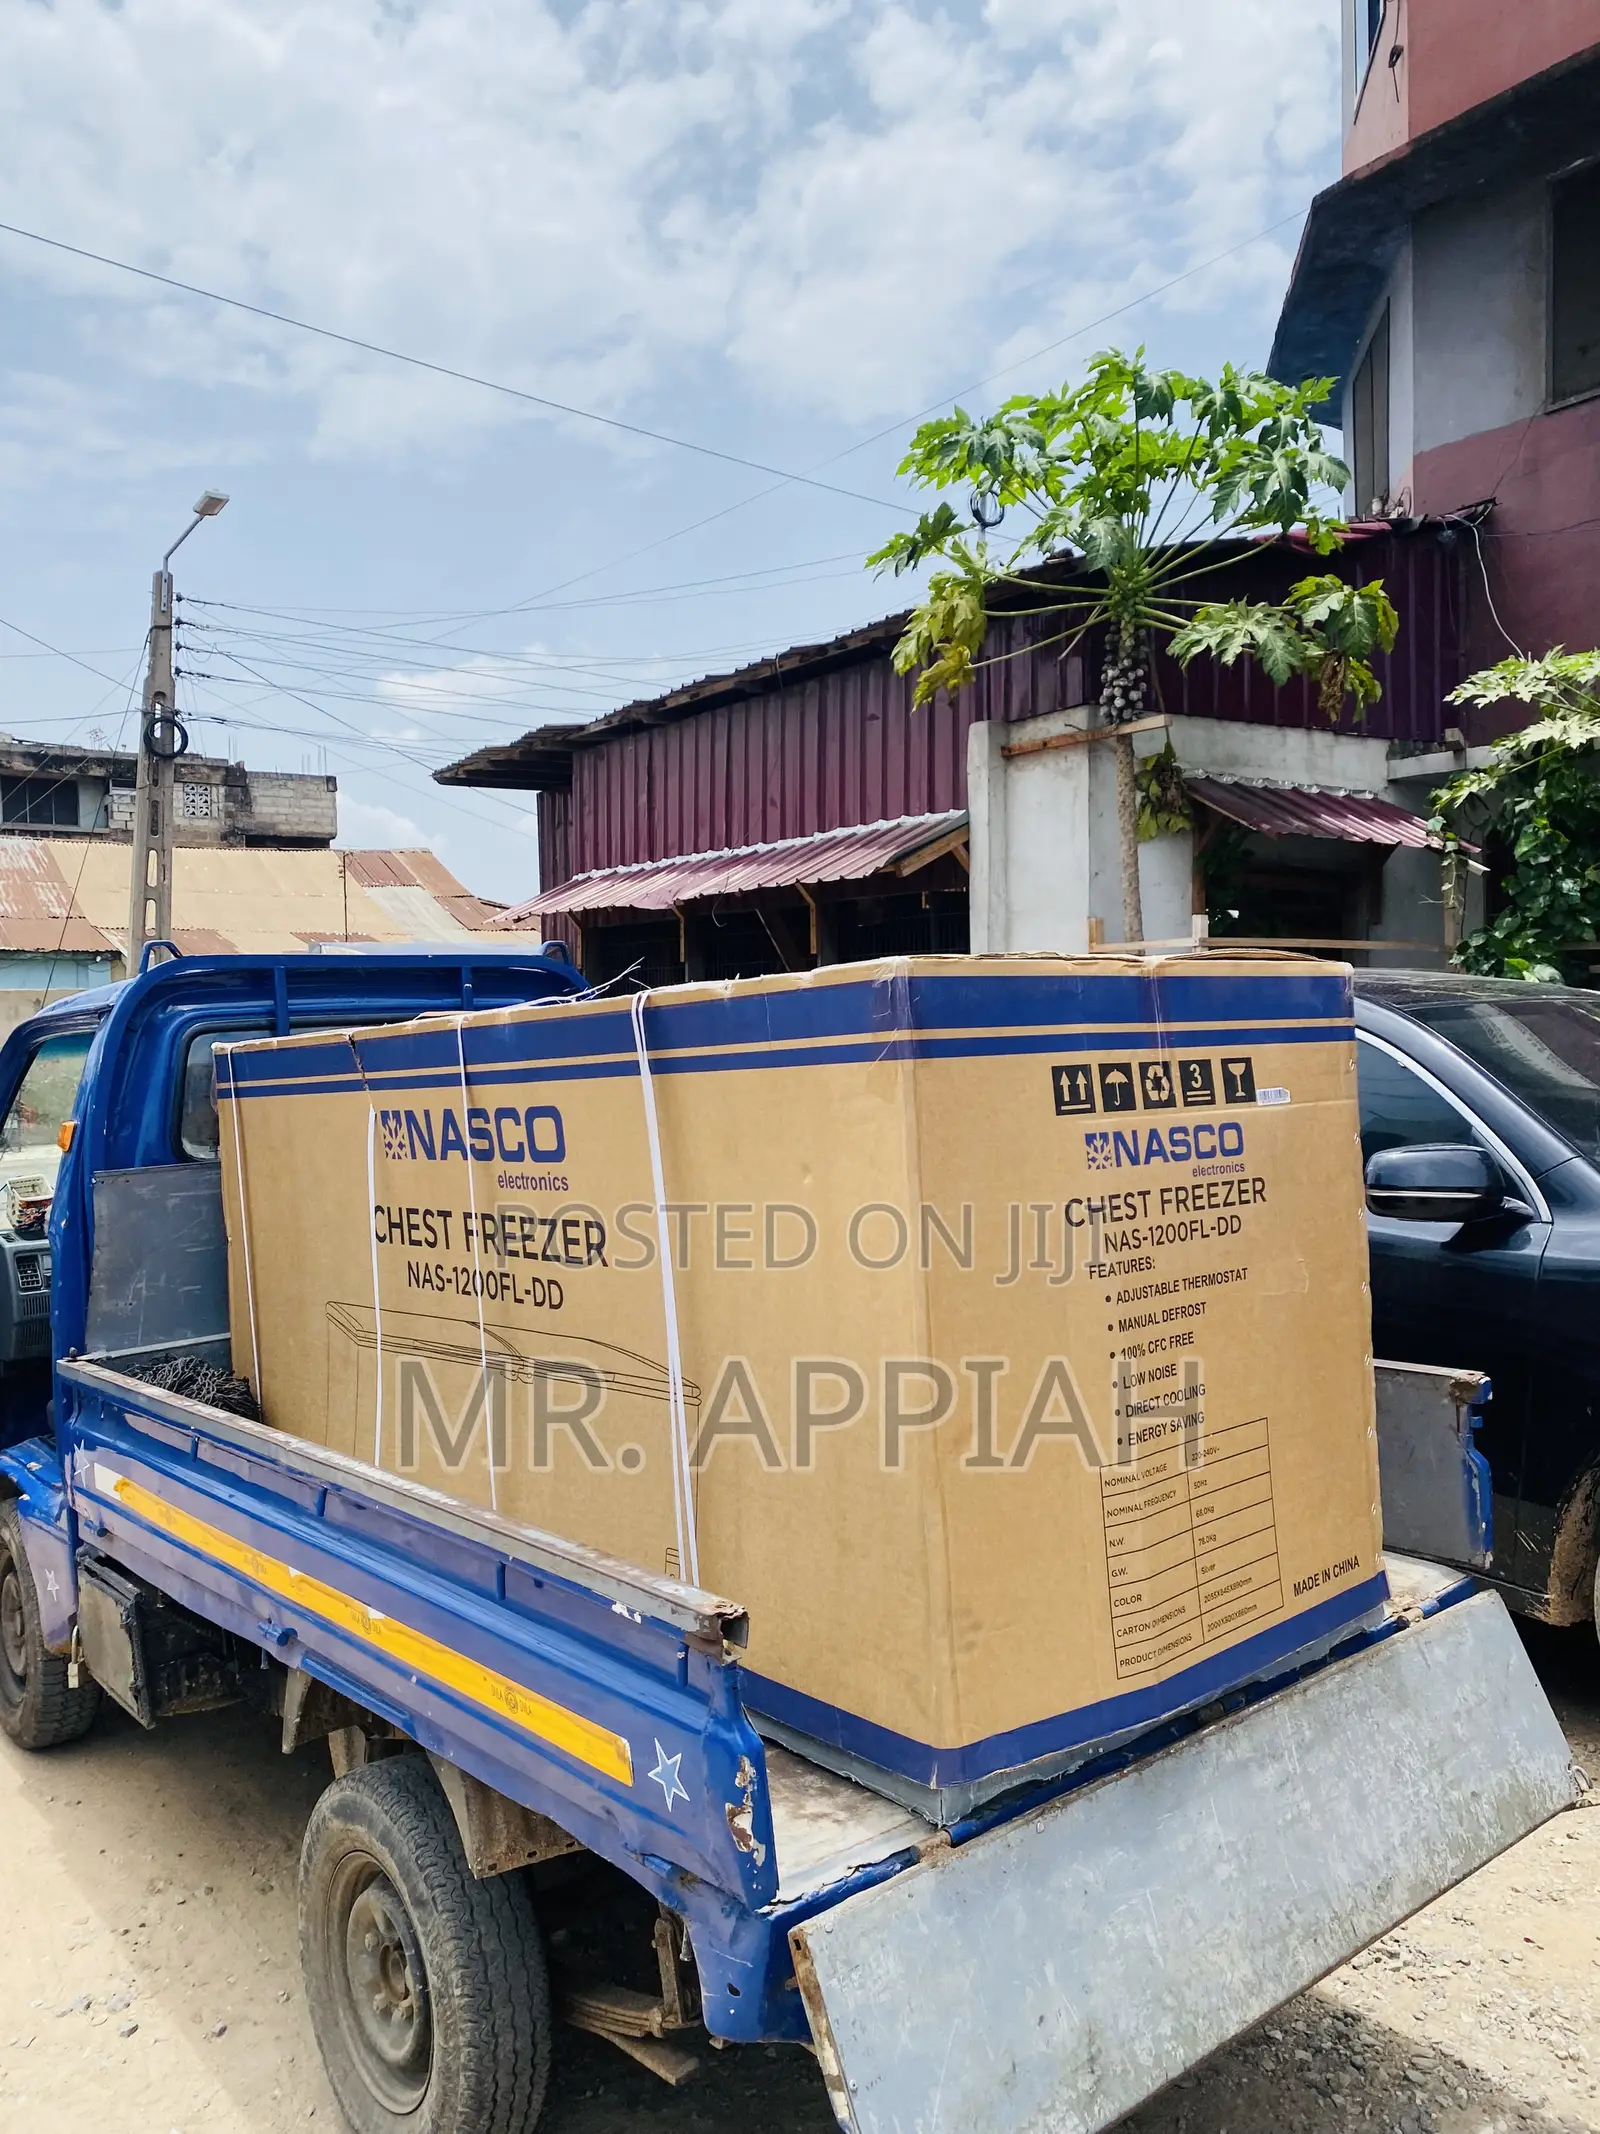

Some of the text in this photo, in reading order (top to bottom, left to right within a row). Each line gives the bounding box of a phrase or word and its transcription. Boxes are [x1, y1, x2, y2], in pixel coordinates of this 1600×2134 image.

[1190, 1063, 1203, 1088] 3
[404, 1105, 566, 1163] NASCO
[1112, 1121, 1245, 1168] NASCO
[497, 1170, 569, 1191] electronics
[1192, 1162, 1245, 1177] electronics
[1064, 1176, 1268, 1228] CHEST FREEZER
[375, 1205, 609, 1268] CHEST FREEZER
[1104, 1214, 1242, 1255] NAS-1200FL-DD
[1089, 1256, 1156, 1279] FEATURES:
[407, 1260, 564, 1310] NAS-1200FL-DD
[1116, 1268, 1248, 1304] ADJUSTABLE THERMOSTAT
[1118, 1302, 1207, 1333] MANUAL DEFROST
[1121, 1331, 1195, 1361] 100% CFC FREE
[1123, 1363, 1178, 1390] LOW NOISE
[1125, 1383, 1206, 1418] DIRECT COOLING
[1128, 1411, 1205, 1447] ENERGY SAVING
[1104, 1463, 1169, 1488] NOMINAL VOLTAGE
[1106, 1489, 1177, 1519] NOMINAL FREQUENCY
[1293, 1555, 1360, 1597] MADE IN CHINA
[1113, 1593, 1143, 1608] COLOR
[1116, 1605, 1186, 1638] CARTON DIMENSIONS
[1119, 1632, 1193, 1668] PRODUCT DIMENSIONS
